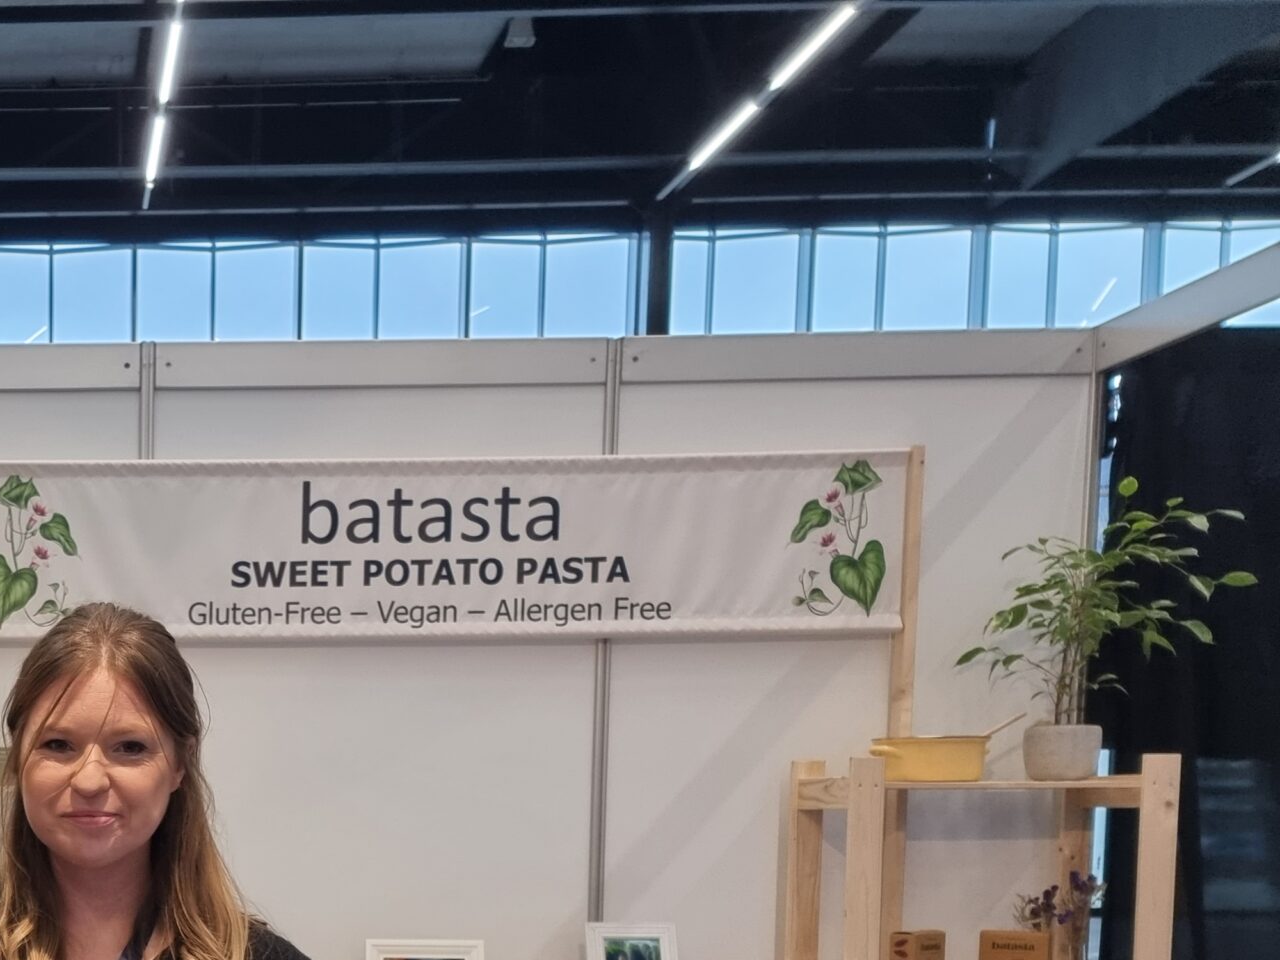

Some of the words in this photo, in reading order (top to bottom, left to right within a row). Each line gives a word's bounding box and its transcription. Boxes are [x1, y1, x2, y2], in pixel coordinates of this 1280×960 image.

[301, 480, 562, 544] batasta
[230, 560, 352, 588] SWEET
[363, 558, 504, 587] POTATO
[516, 556, 631, 584] PASTA
[188, 601, 342, 626] Gluten-Free
[376, 600, 458, 629] Vegan
[493, 598, 606, 627] Allergen
[614, 598, 672, 621] Free
